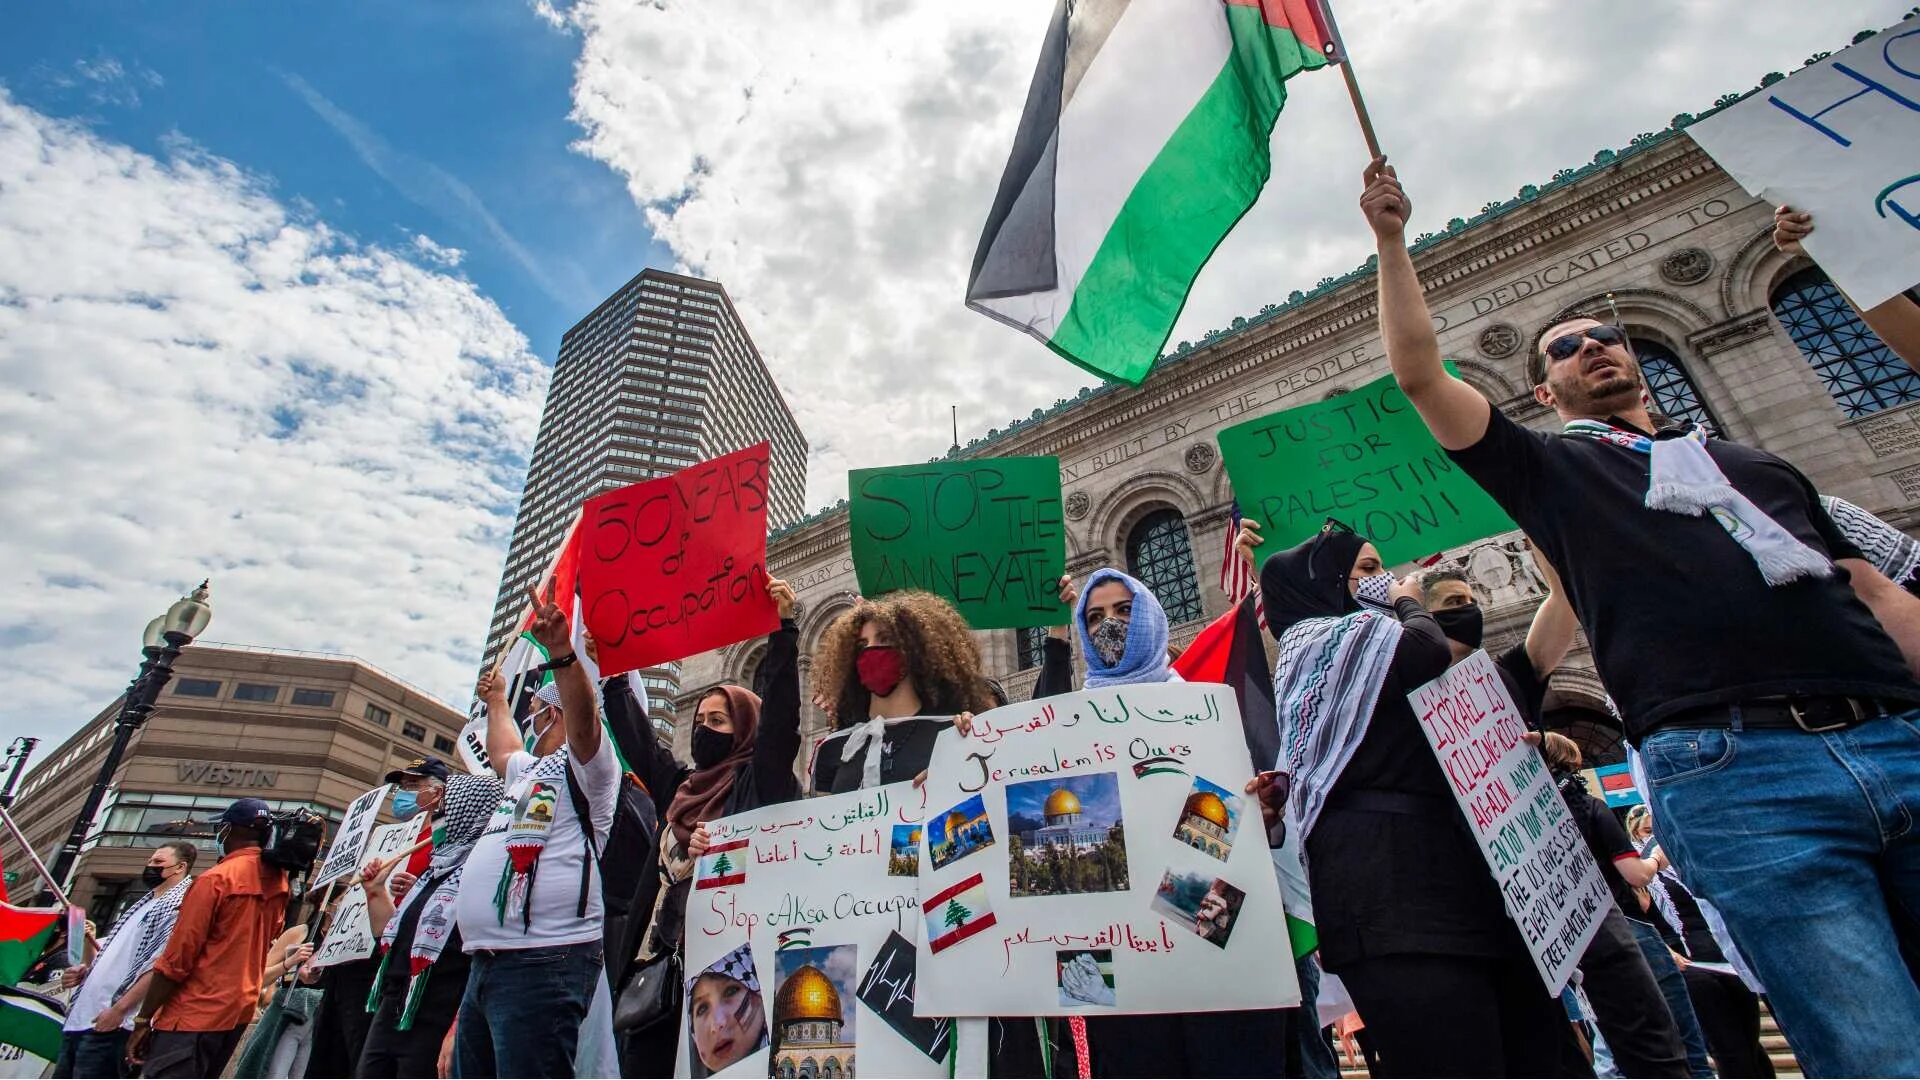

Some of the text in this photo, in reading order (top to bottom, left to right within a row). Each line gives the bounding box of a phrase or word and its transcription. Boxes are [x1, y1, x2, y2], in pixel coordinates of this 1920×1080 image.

[1471, 199, 1730, 316] DEDICATED TO
[1093, 346, 1371, 472] BUILT BY THE PEOPLE
[1316, 433, 1392, 470] FOR
[594, 457, 770, 562] 50 YEARS
[860, 468, 1063, 541] STOP THE
[662, 530, 688, 576] of
[591, 557, 766, 648] Occupation
[1134, 693, 1219, 726] البيت
[1423, 673, 1505, 750] ISRAEL IS
[177, 760, 279, 788] WESTIN
[959, 737, 1192, 792] Jerusalem is Ours
[1444, 714, 1521, 796] KILLING KIDS
[1509, 745, 1542, 792] ANYWAY
[347, 815, 364, 833] ALL
[351, 790, 380, 820] END
[804, 843, 833, 866] في
[1488, 819, 1525, 872] ENJOY
[1515, 803, 1546, 845] YOUR
[1503, 869, 1530, 913] THE
[1542, 836, 1566, 875] GIVES
[702, 891, 759, 939] Stop
[833, 892, 919, 932] Occupa
[1522, 896, 1556, 946] EVERY
[1541, 937, 1567, 983] FREE
